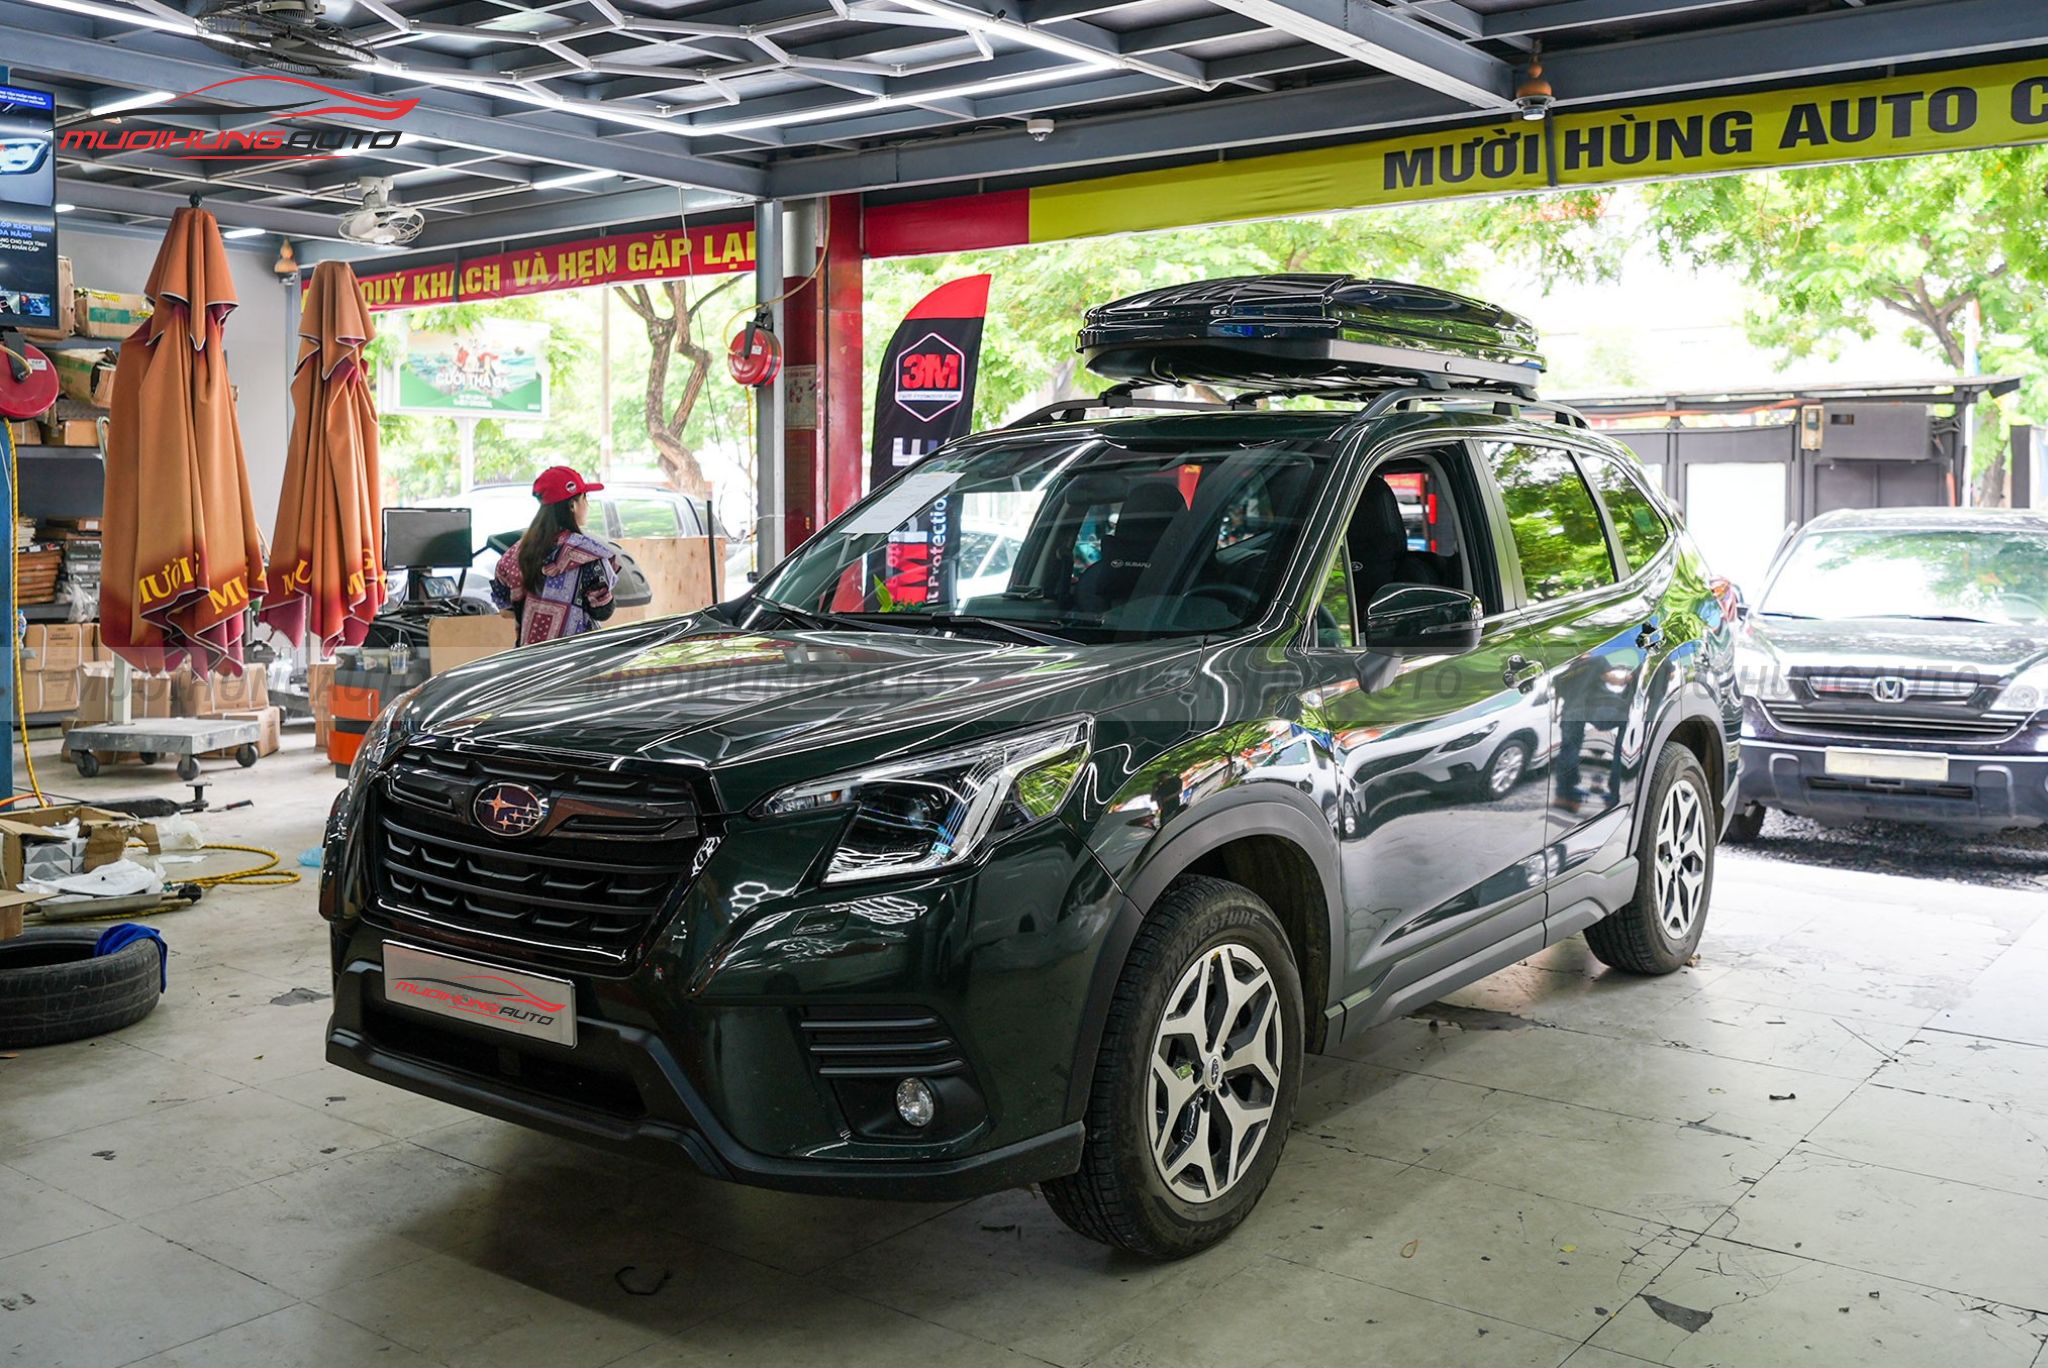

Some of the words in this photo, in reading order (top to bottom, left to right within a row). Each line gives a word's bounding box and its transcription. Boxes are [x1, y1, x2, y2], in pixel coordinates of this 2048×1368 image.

[1383, 130, 1540, 191] MƯỜI
[1564, 112, 1753, 171] HÙNG
[1779, 86, 1979, 150] AUTO
[512, 252, 550, 287] VÀ
[558, 245, 617, 284] HẸN
[627, 234, 692, 276] GẶP
[902, 353, 960, 389] 3M
[927, 493, 948, 588] Protectio
